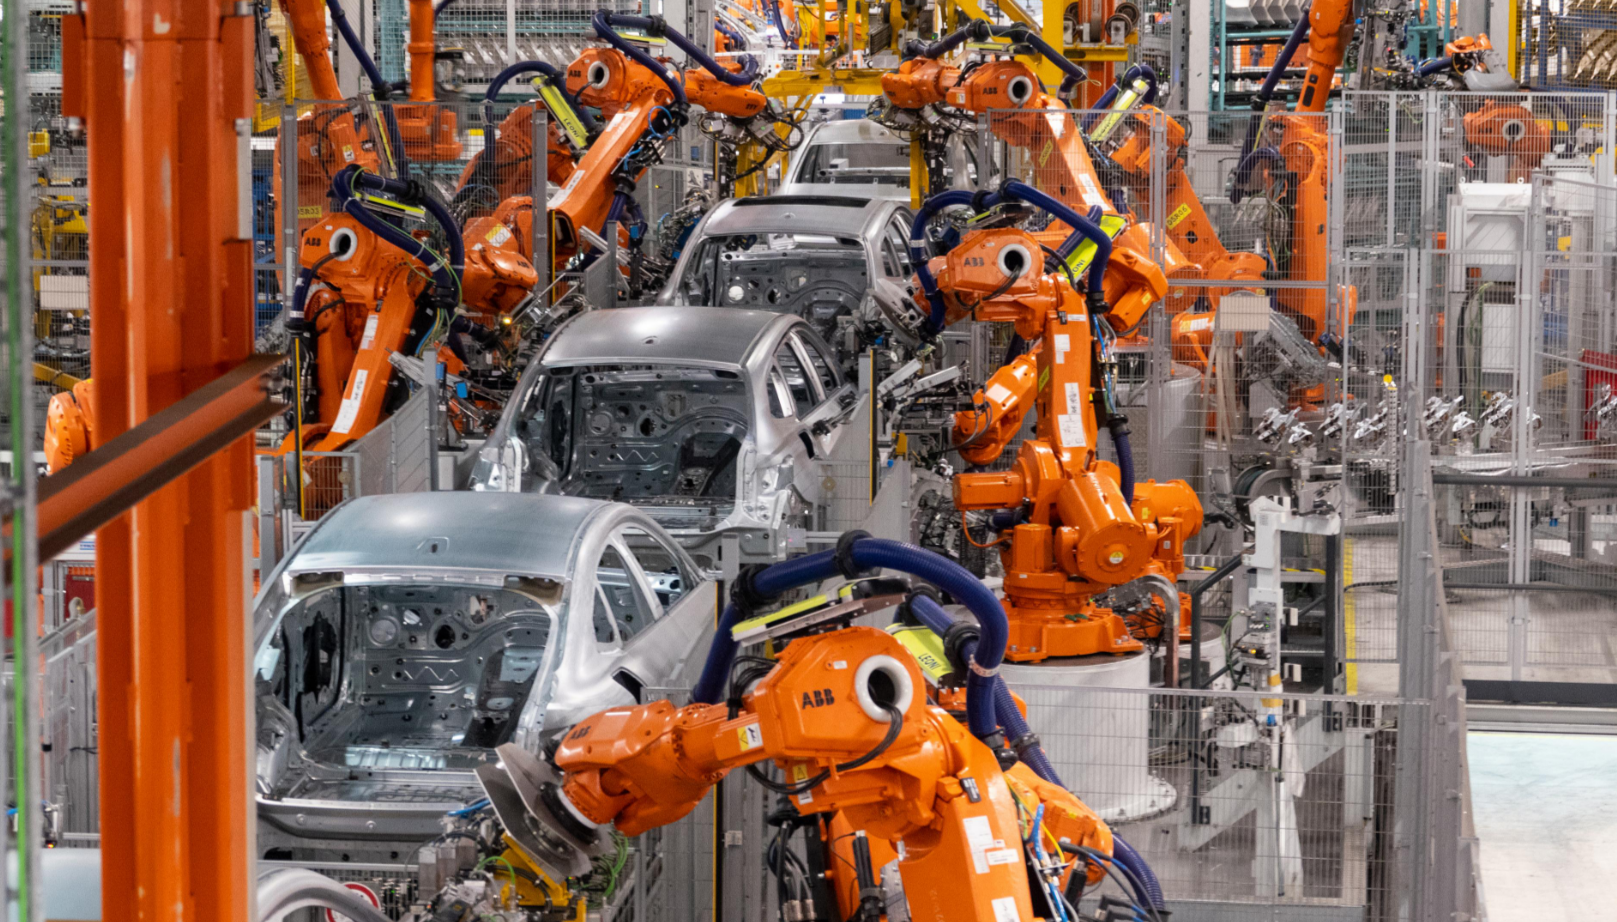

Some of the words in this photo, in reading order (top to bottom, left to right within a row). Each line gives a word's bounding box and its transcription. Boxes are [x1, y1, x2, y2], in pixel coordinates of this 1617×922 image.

[982, 87, 998, 95] ABB
[563, 117, 580, 138] LEONI
[305, 237, 321, 247] ABB
[963, 257, 985, 267] ABB
[918, 653, 942, 671] LEONI
[802, 688, 835, 709] ABB
